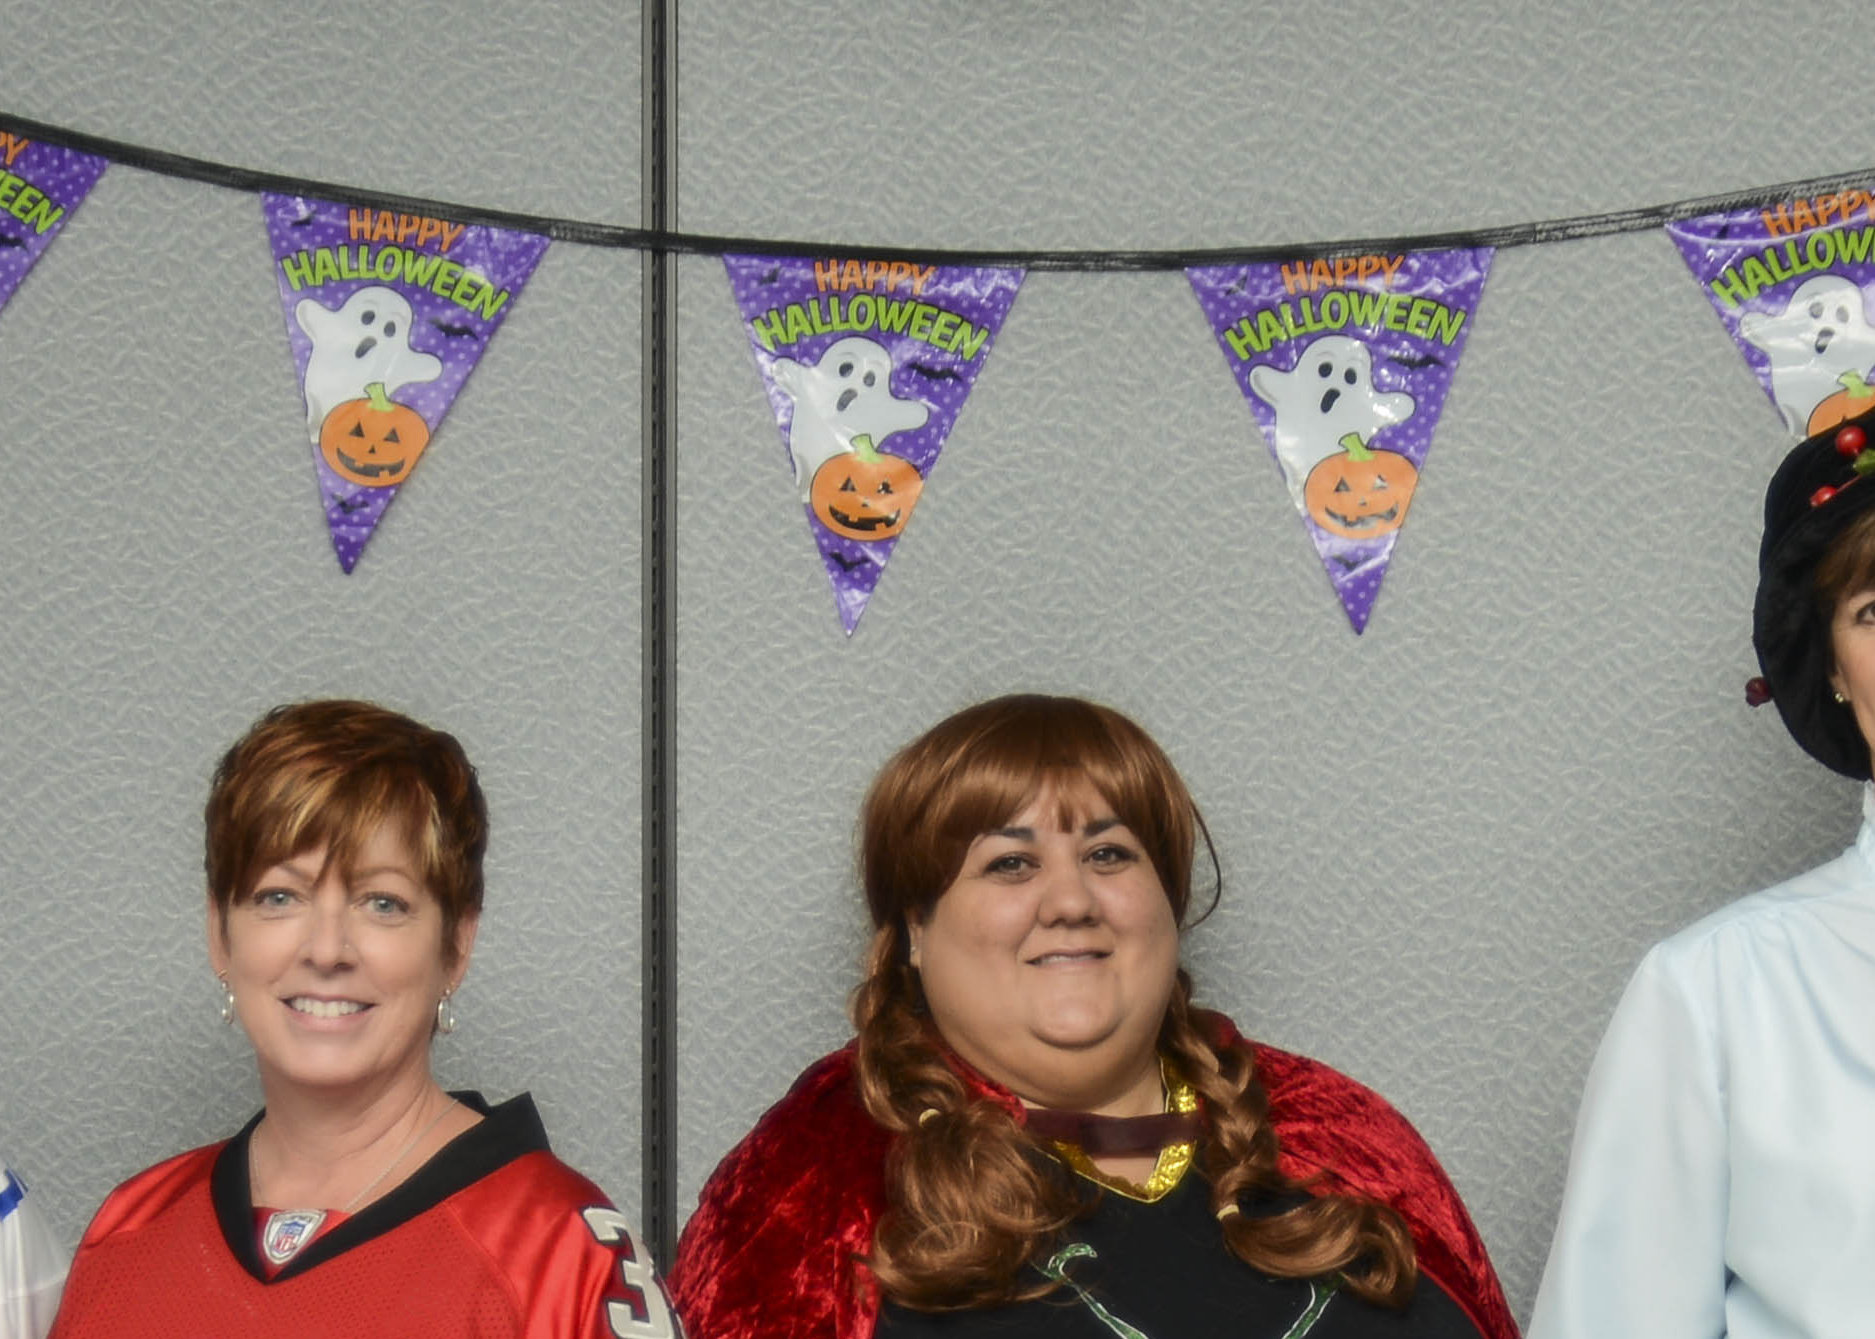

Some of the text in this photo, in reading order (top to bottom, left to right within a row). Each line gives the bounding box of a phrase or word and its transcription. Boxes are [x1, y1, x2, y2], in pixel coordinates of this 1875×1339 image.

[348, 208, 465, 252] HAPPY
[281, 244, 509, 321] HALLOWEEN
[814, 258, 937, 297] HAPPY
[1281, 254, 1405, 295] HAPPY
[752, 294, 989, 361] HALLOWEEN
[1224, 291, 1468, 361] HALLOWEEN
